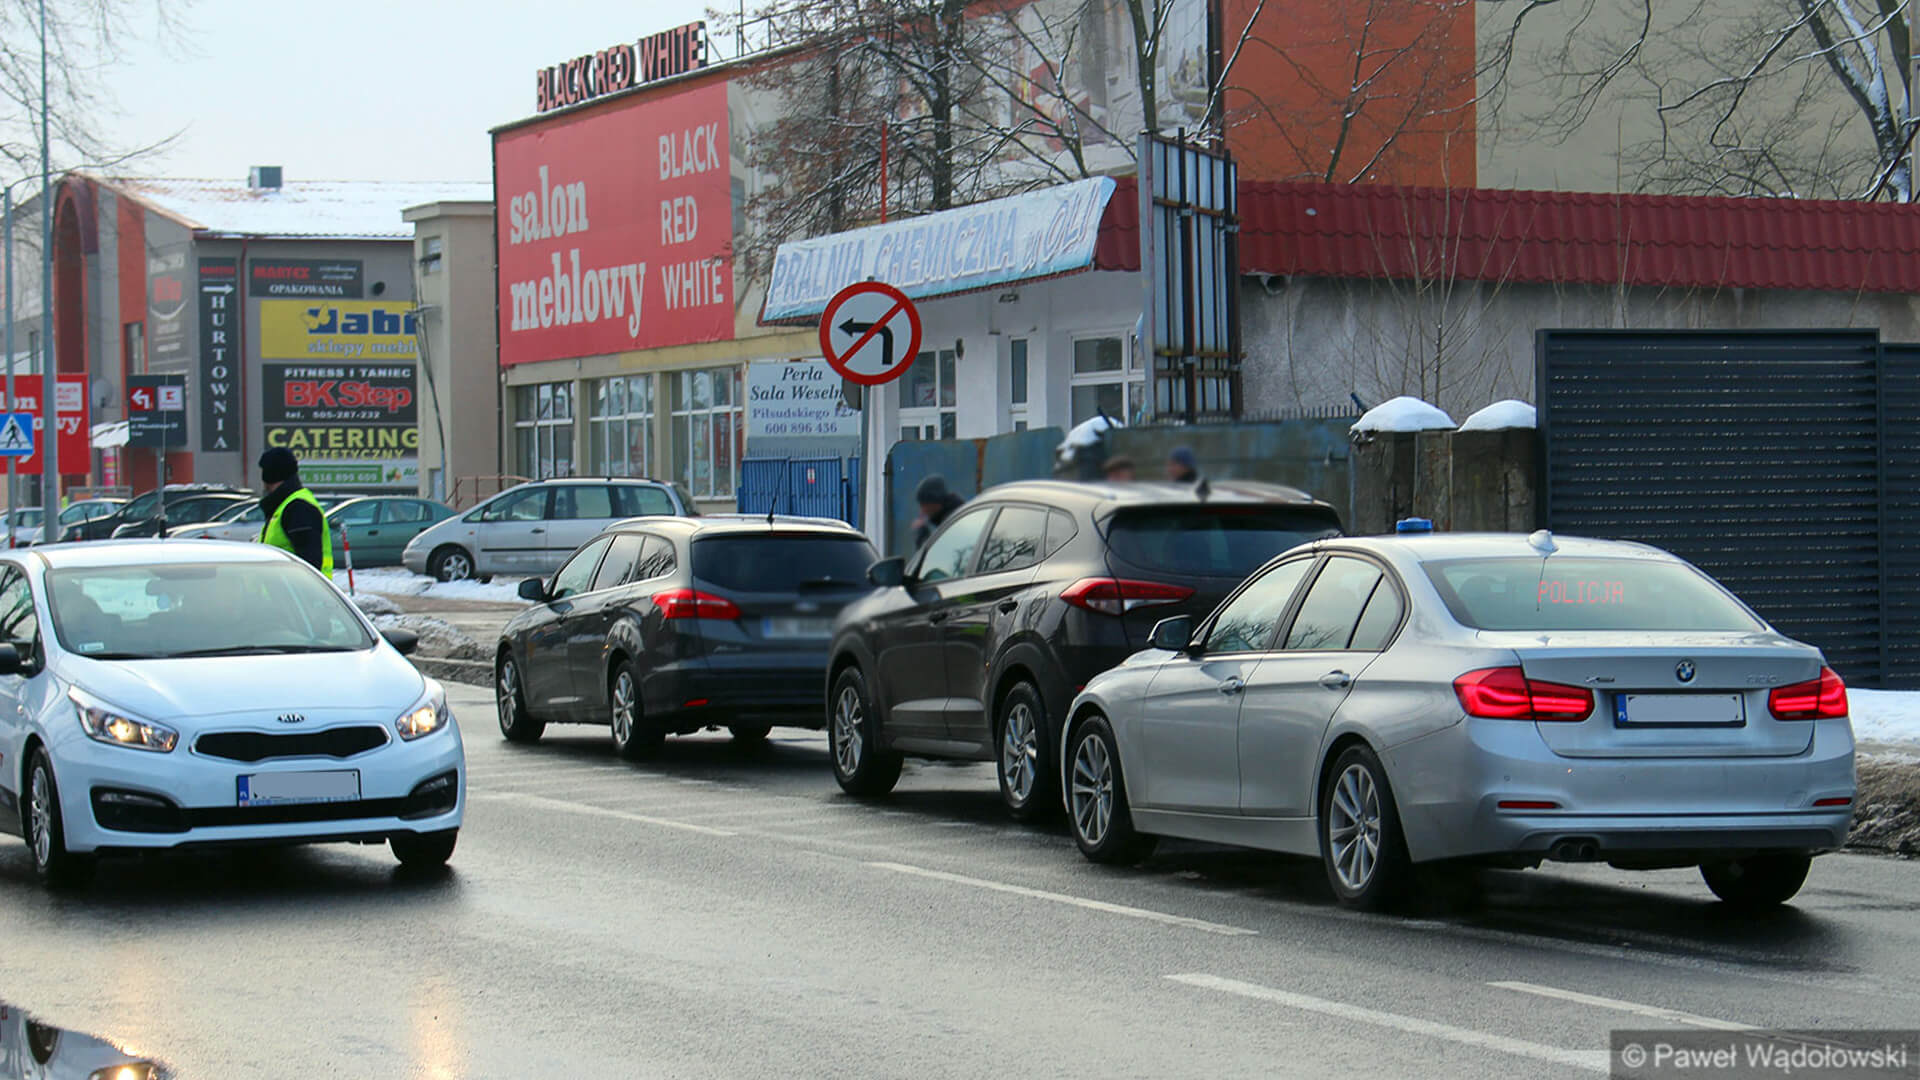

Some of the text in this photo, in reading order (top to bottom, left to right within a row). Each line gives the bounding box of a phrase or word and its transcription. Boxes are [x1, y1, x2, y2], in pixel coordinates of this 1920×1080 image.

[537, 21, 707, 112] BLACK RED WHITE
[659, 122, 720, 181] BLACK
[510, 165, 589, 244] salon
[661, 195, 698, 246] RED
[768, 239, 865, 304] PRALNIA
[873, 206, 1017, 288] CHEMICZNA
[1043, 182, 1098, 262] OLI
[269, 284, 344, 295] OPAKOWANIA
[510, 248, 646, 338] meblowy
[662, 258, 724, 311] WHITE
[308, 340, 365, 356] sklepy
[210, 296, 230, 448] HURTOWNIA
[284, 368, 345, 377] FITNESS
[359, 368, 411, 377] TANIEC
[751, 385, 785, 401] Sala
[268, 428, 418, 448] CATERING
[765, 422, 838, 433] 600 896 436
[294, 450, 404, 460] DIETETYCZNY
[1537, 581, 1625, 604] POLICJA
